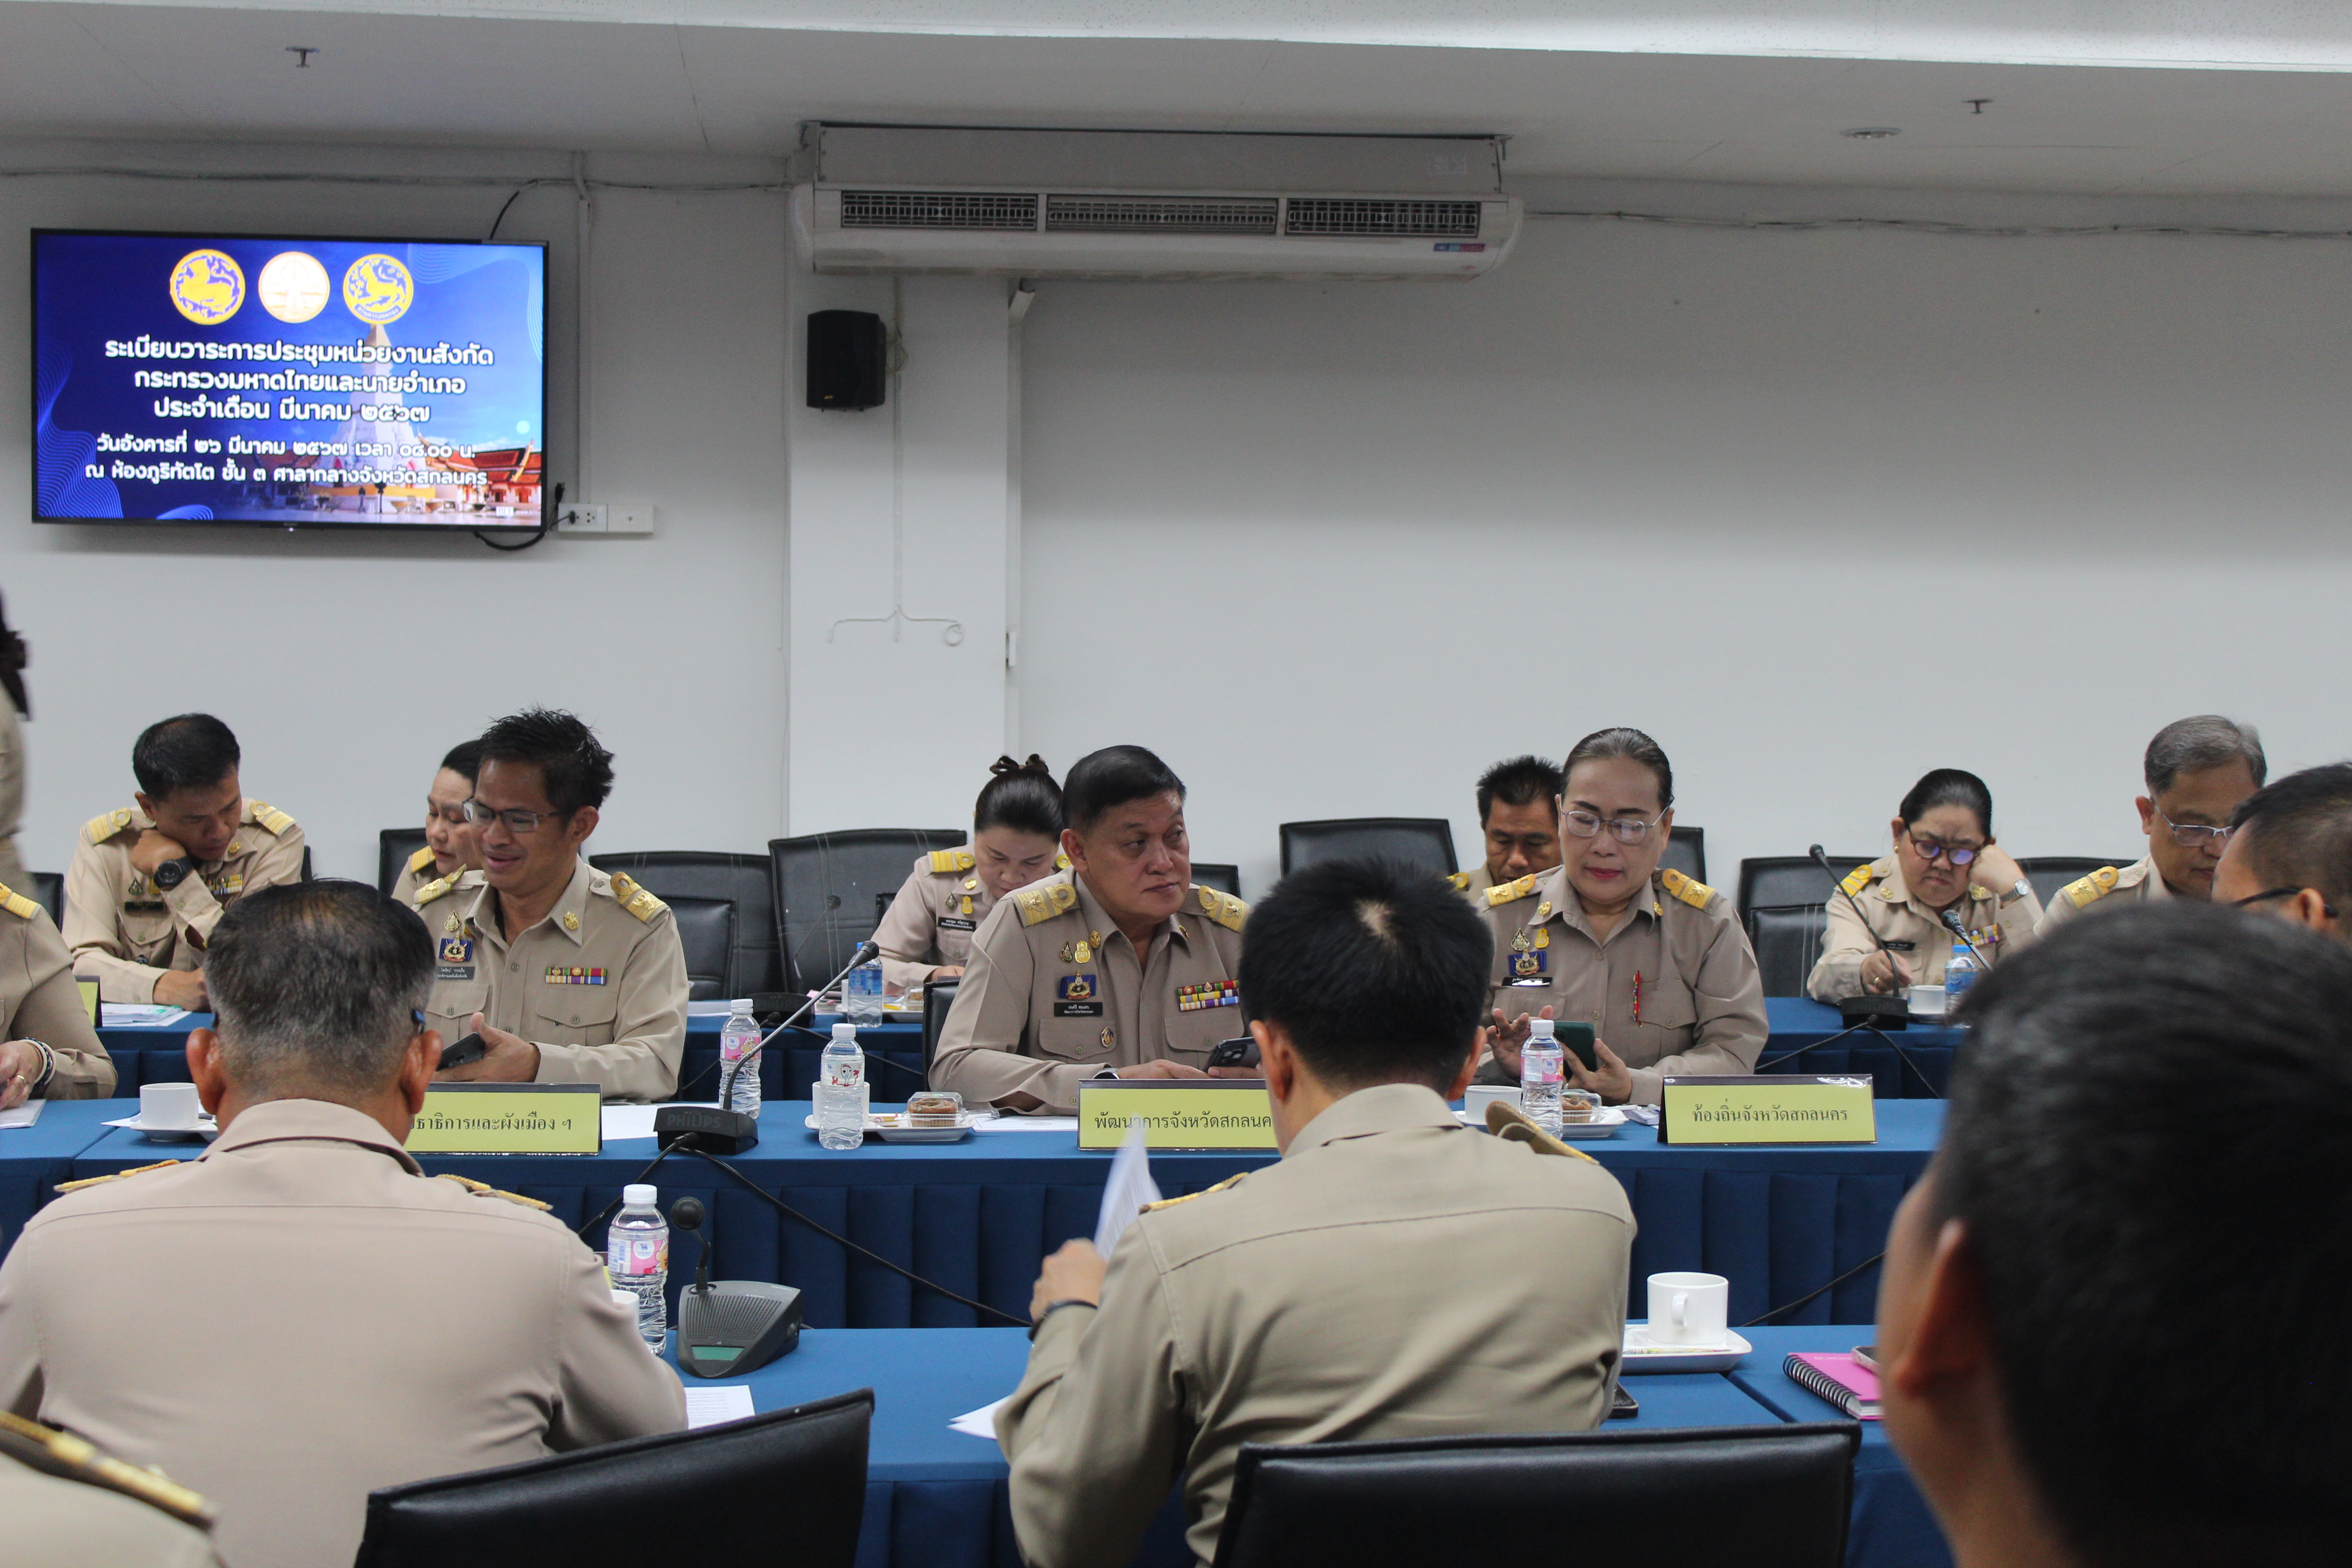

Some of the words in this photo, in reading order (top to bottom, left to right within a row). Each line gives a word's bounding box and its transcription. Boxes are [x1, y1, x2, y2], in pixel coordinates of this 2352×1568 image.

[105, 333, 494, 368] ระเบียบวาระการประชุมหน่วยงานสังกัด
[134, 368, 466, 394] กระทรวงมหาดไทยและนายอำเภอ
[154, 393, 271, 419] ประจำเดือน
[279, 395, 352, 421] มีนาคม
[360, 403, 431, 422] ๒๕๖๗
[97, 429, 188, 453] วันอังคารที่
[194, 438, 222, 454] ๒๖
[228, 434, 286, 455] มีนาคม
[293, 441, 348, 456] ๒๕๖๗
[355, 442, 393, 457] เวลา
[459, 444, 476, 458] น.
[85, 464, 104, 479] ณ
[111, 459, 215, 484] ห้องภูริทัตโต
[222, 457, 246, 481] ชั้น
[253, 467, 267, 481] ๓
[273, 465, 488, 485] ศาลากลางจังหวัดสกลนคร
[410, 1111, 555, 1130] ธาธิการและผังเมือง
[667, 1114, 721, 1128] PHILIPS
[1692, 1099, 1847, 1122] ท้องถิ่นจังหวัดสกลนคร
